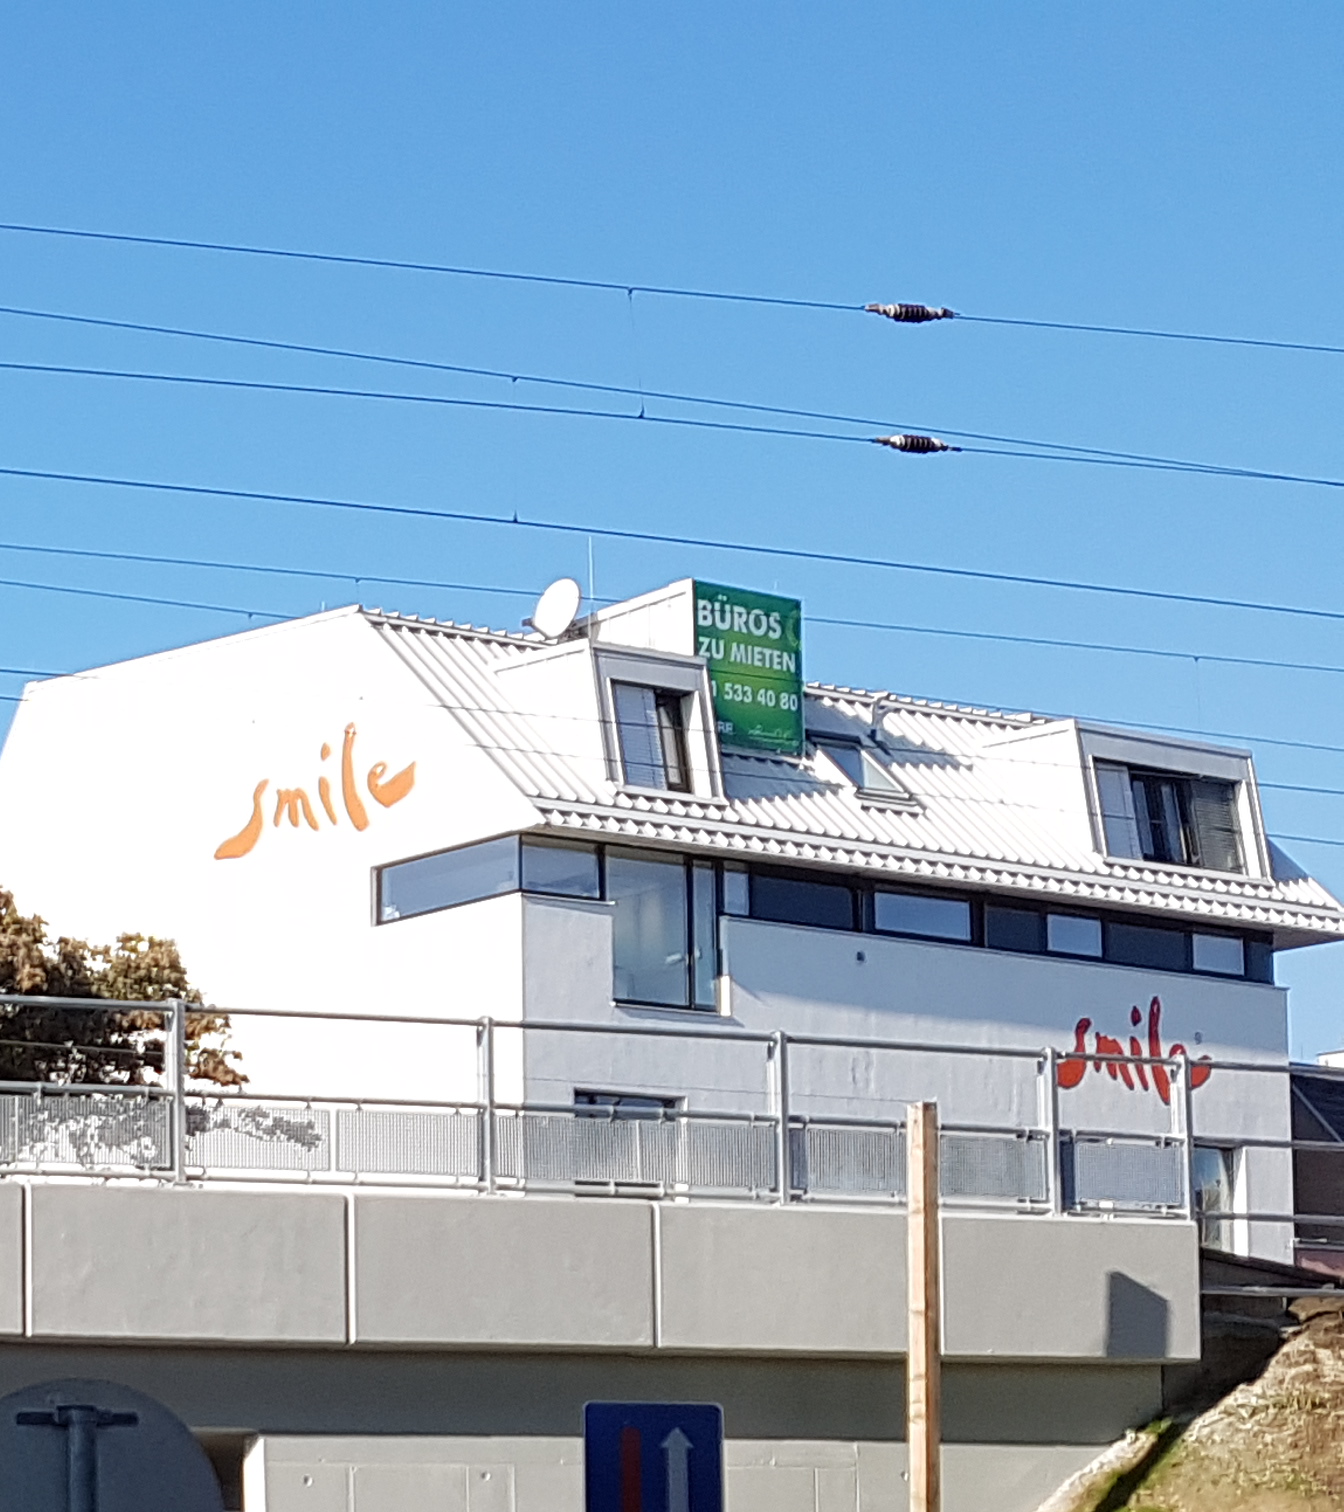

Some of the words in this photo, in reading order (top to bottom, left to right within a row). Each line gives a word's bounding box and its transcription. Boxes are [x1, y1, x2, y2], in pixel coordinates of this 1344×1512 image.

[697, 594, 782, 640] BÜROS
[698, 636, 725, 660] ZU
[730, 642, 796, 674] MIETEN
[724, 682, 753, 704] 533
[757, 688, 776, 708] 40
[780, 692, 799, 712] 80
